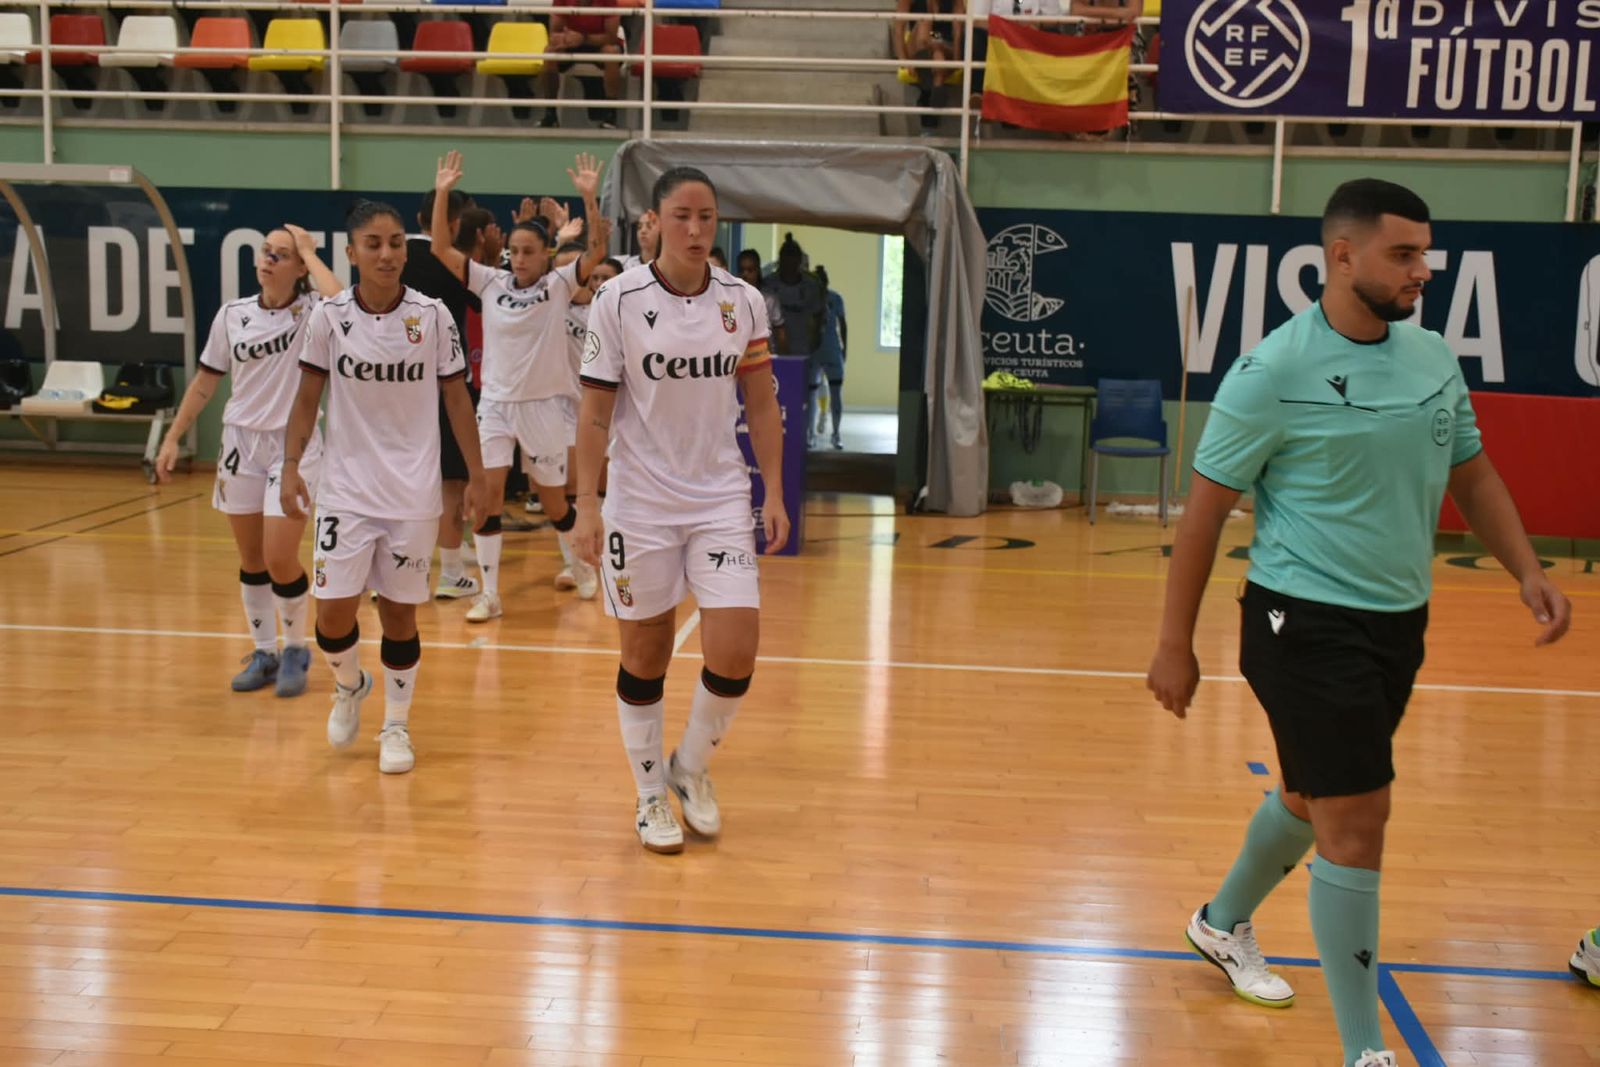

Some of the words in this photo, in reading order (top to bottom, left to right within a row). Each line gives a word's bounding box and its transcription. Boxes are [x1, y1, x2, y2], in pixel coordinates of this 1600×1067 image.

[1226, 24, 1269, 42] RF
[1225, 48, 1268, 66] EF
[1406, 26, 1596, 112] FÚTBOL
[88, 226, 195, 334] DE
[337, 354, 424, 382] Ceuta
[642, 351, 739, 381] Ceuta
[609, 532, 625, 570] 9
